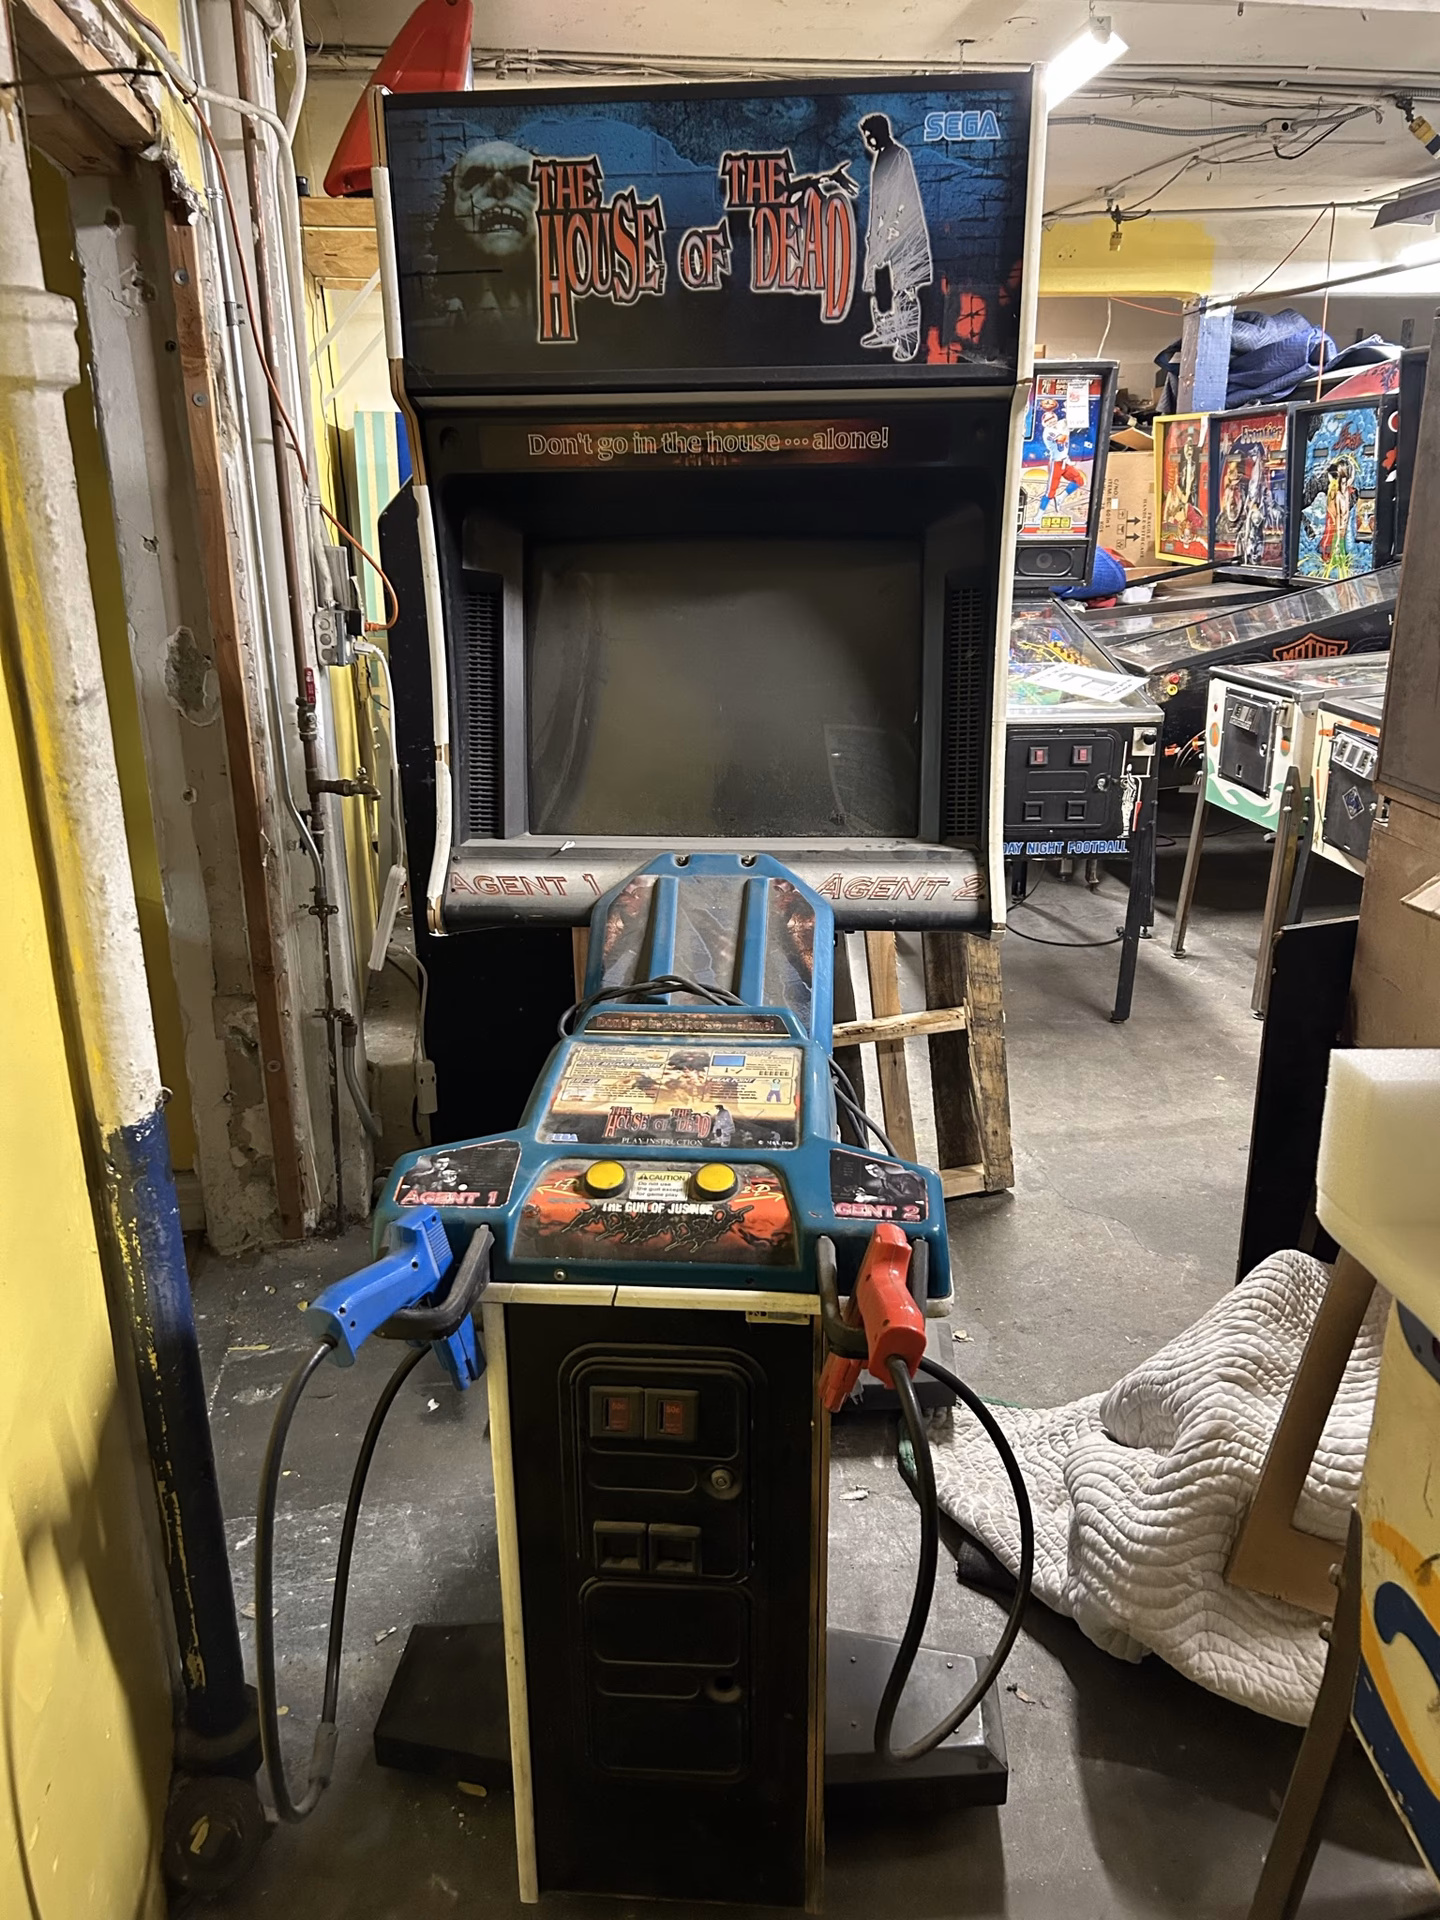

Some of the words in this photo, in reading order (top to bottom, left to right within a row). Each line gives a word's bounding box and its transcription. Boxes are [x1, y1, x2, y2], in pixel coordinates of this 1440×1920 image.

[924, 110, 1001, 141] SEGA
[531, 156, 603, 210] THE
[721, 150, 795, 207] THE
[537, 187, 666, 342] HOUSE
[680, 217, 732, 290] OF
[752, 186, 856, 323] DEAD
[528, 433, 593, 456] Don't
[598, 437, 628, 461] go
[633, 432, 657, 454] in
[662, 431, 701, 453] the
[706, 430, 780, 453] house
[812, 426, 889, 450] alone!
[1240, 422, 1284, 445] Frontier
[1283, 640, 1338, 660] MOTOR
[1026, 842, 1064, 855] NIGHT
[450, 873, 568, 897] AGENT
[582, 872, 601, 895] 1
[814, 874, 951, 900] AGENT
[953, 874, 986, 900] 2
[596, 1015, 629, 1029] Don't
[630, 1020, 646, 1031] go
[685, 1018, 722, 1030] house
[610, 1106, 633, 1115] THE
[670, 1108, 693, 1118] THE
[602, 1112, 650, 1138] HOUSE
[676, 1112, 712, 1138] DEAD
[648, 1174, 686, 1182] CAUTION
[400, 1190, 481, 1205] AGENT
[487, 1190, 499, 1204] 1
[602, 1202, 622, 1212] THE
[625, 1202, 649, 1213] GUN
[651, 1202, 665, 1213] OF
[903, 1204, 921, 1220] 2
